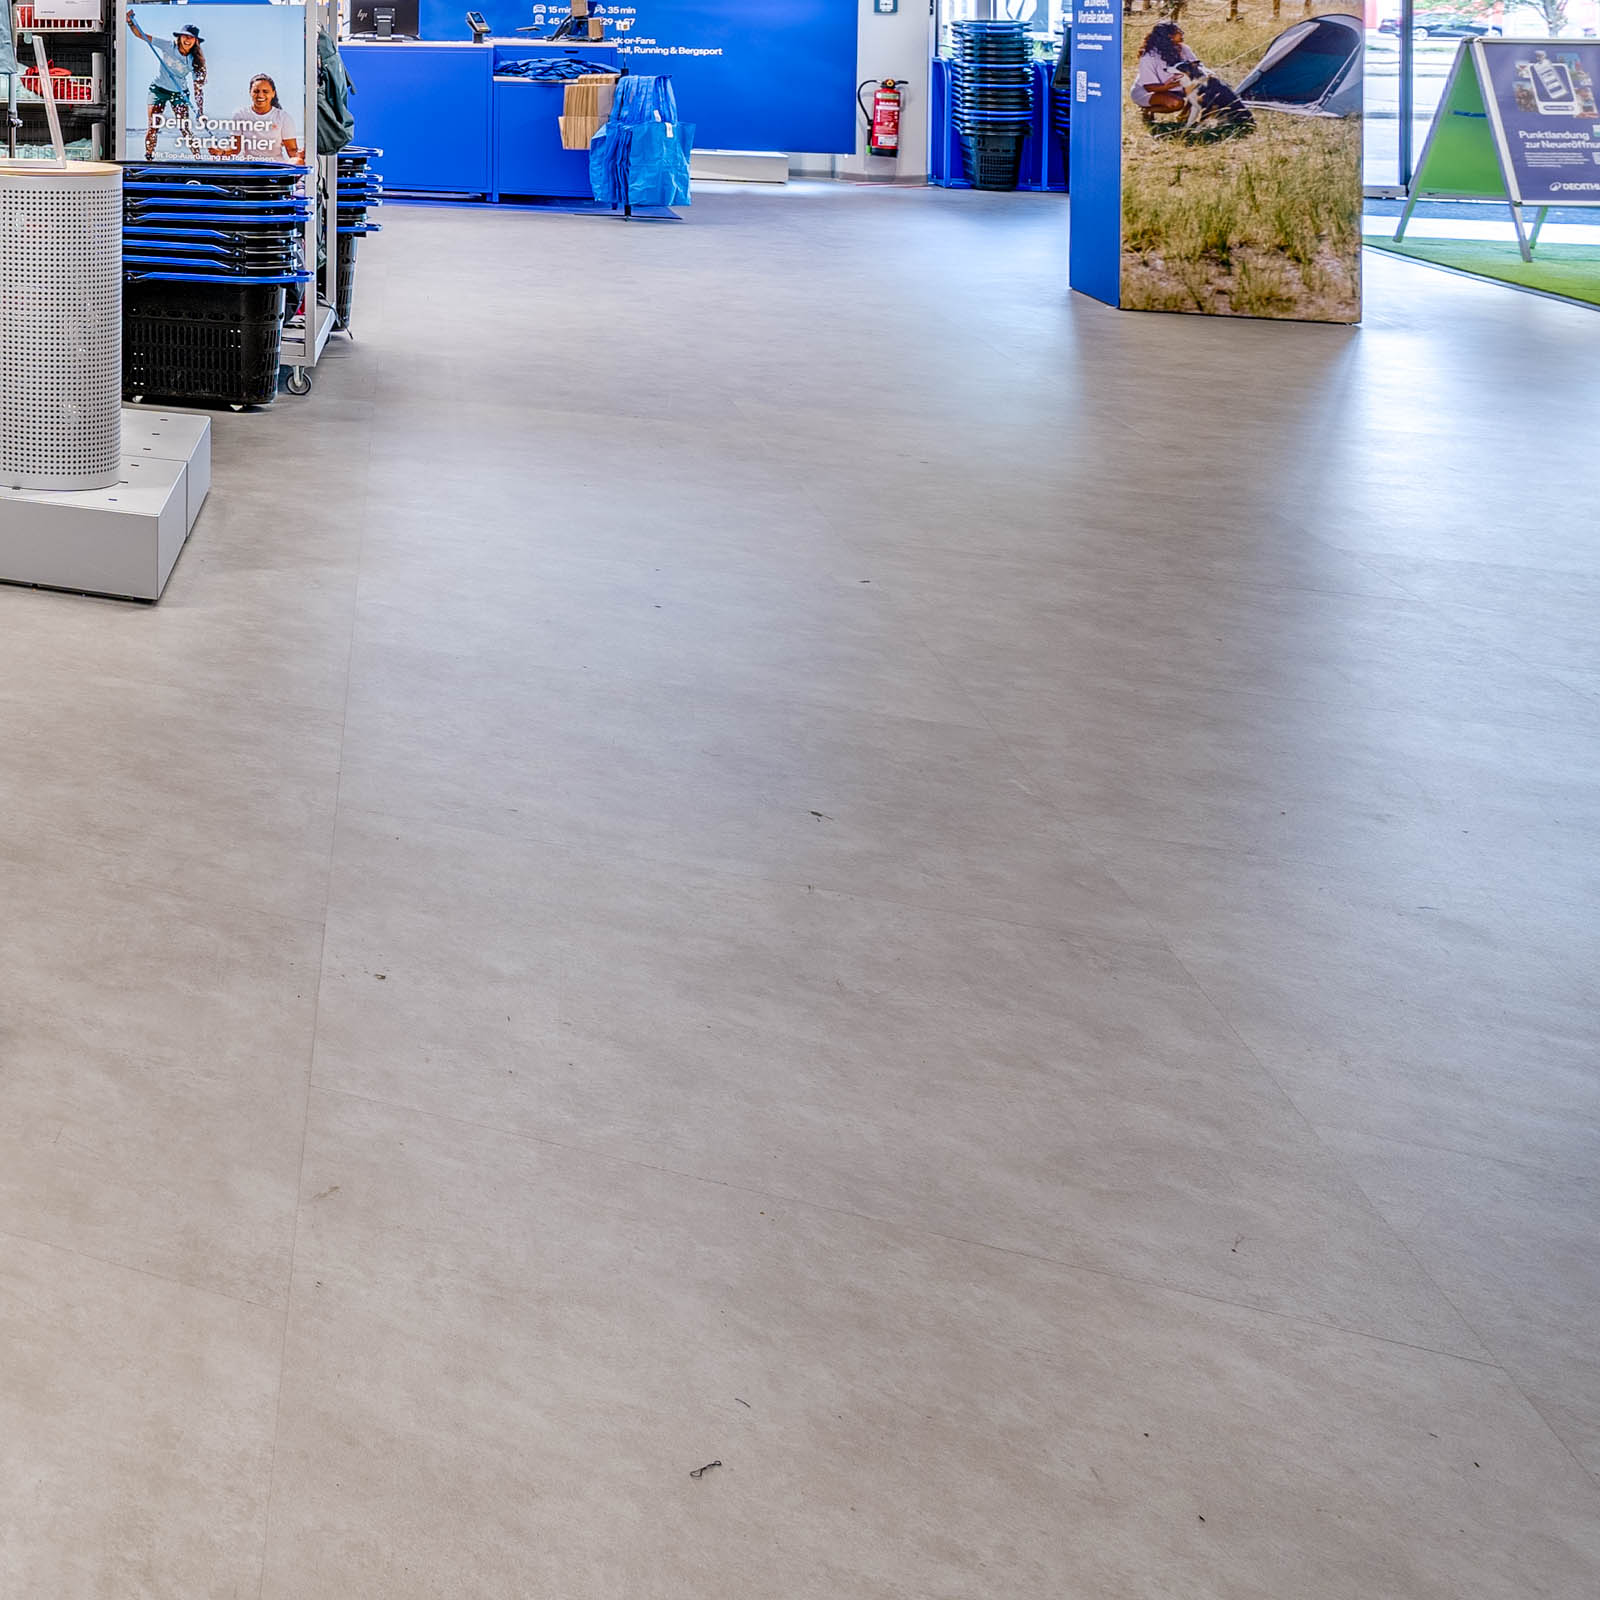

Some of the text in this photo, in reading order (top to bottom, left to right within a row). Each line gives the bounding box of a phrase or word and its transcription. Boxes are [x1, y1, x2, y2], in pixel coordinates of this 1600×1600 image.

[607, 6, 619, 14] 35
[620, 6, 636, 14] min
[634, 46, 668, 56] Running
[678, 47, 722, 56] Bergsport
[152, 114, 272, 132] Dein Sommer
[1519, 130, 1590, 141] Punktlandung
[175, 135, 276, 151] startet hier
